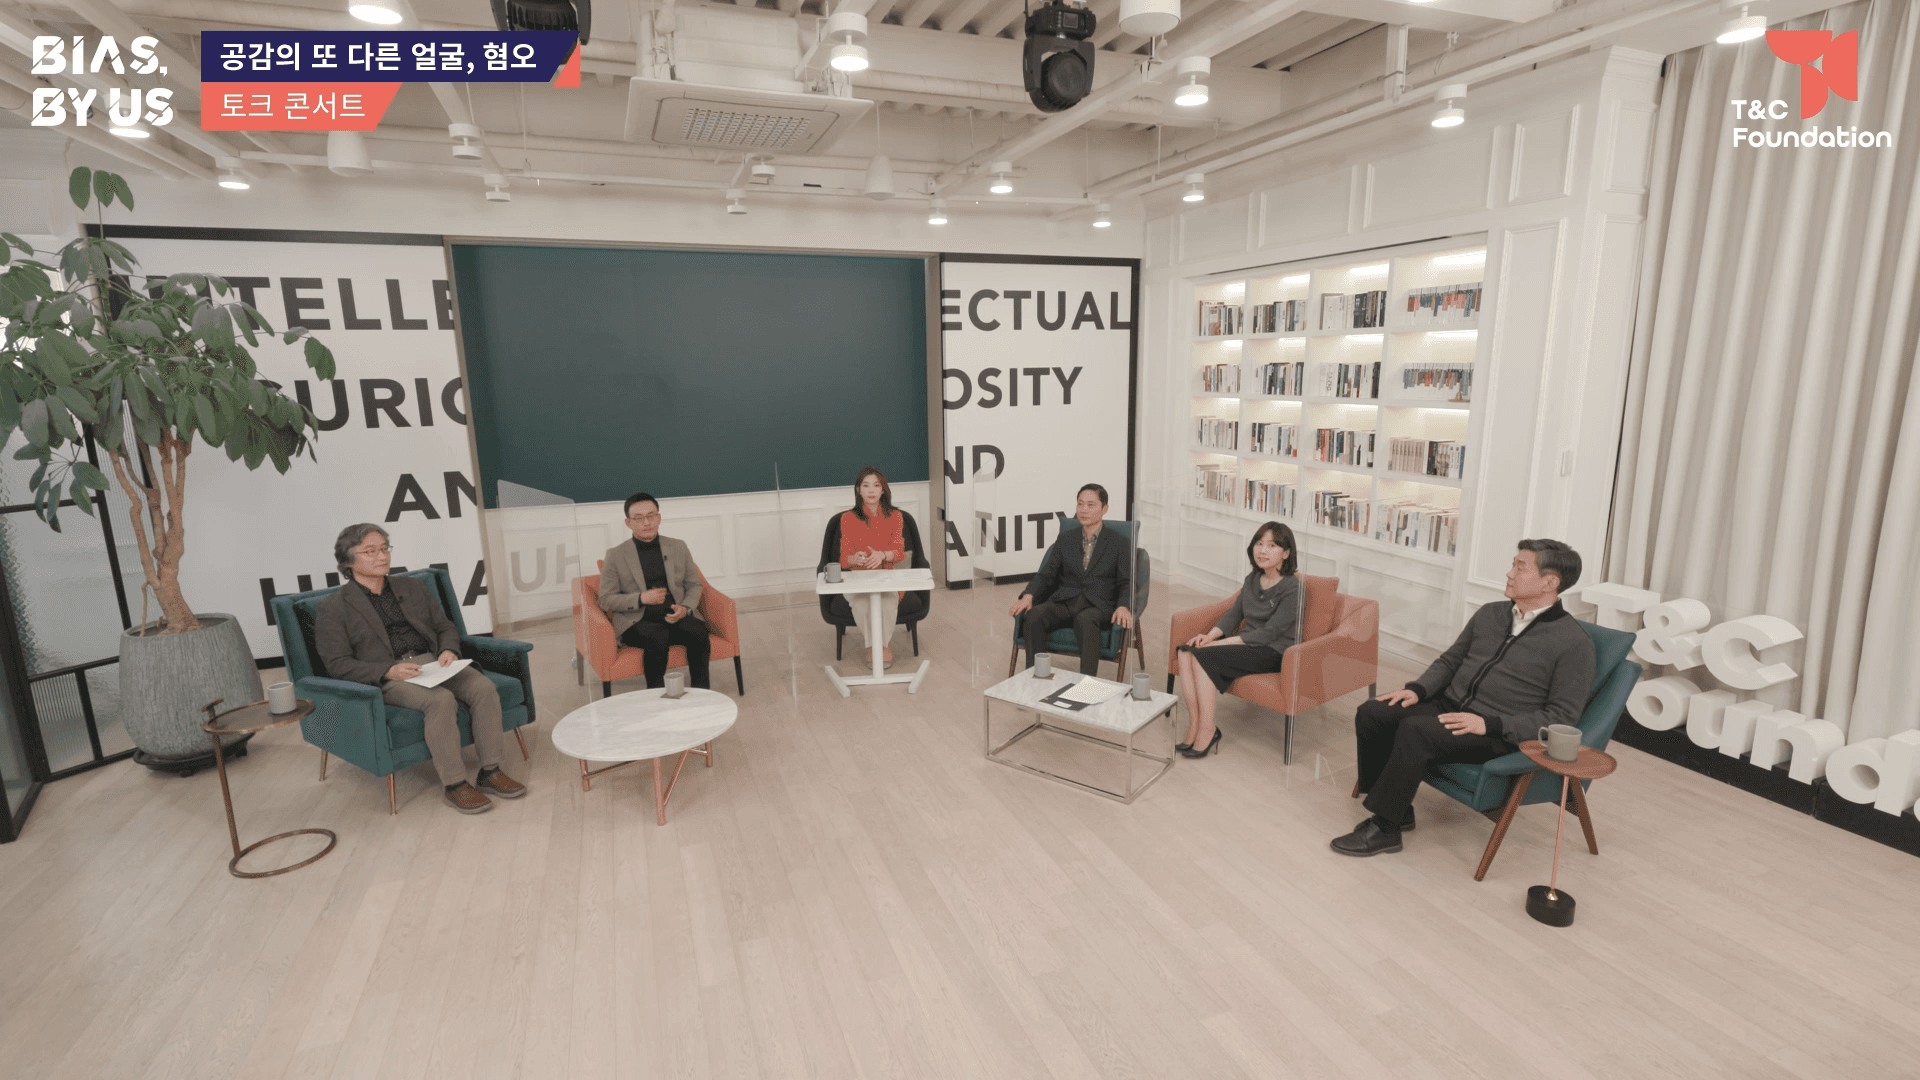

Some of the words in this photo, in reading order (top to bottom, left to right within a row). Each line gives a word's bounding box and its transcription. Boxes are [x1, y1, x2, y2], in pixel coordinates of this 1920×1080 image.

[941, 289, 1131, 332] ECTUAL
[1581, 582, 1804, 691] T&C
[1625, 675, 1920, 824] ound
